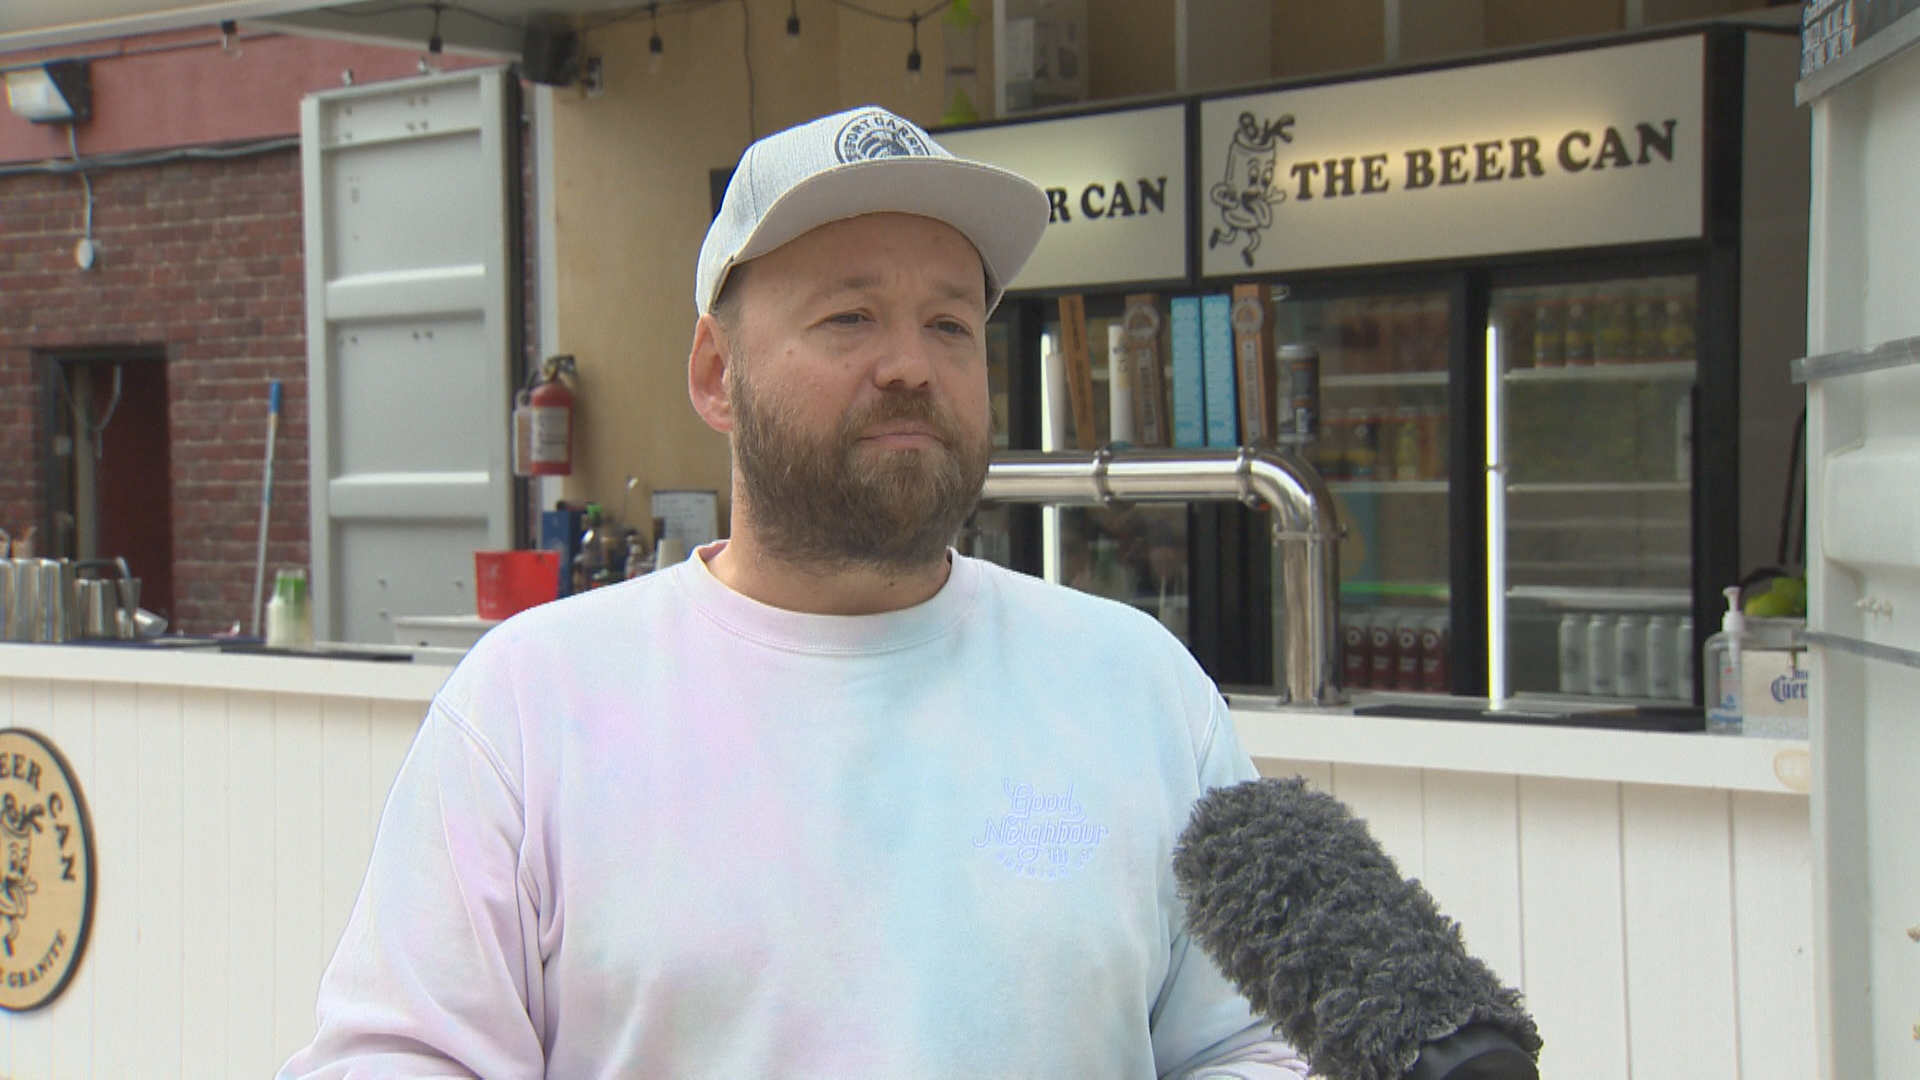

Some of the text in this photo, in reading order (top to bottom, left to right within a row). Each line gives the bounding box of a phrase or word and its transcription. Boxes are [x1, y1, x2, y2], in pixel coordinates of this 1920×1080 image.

[1290, 120, 1677, 200] THE BEER CAN
[1080, 176, 1168, 220] CAN
[1004, 778, 1082, 818] Good
[48, 791, 76, 882] CAN
[972, 814, 1109, 864] Neighbour
[8, 928, 67, 988] GRANITE
